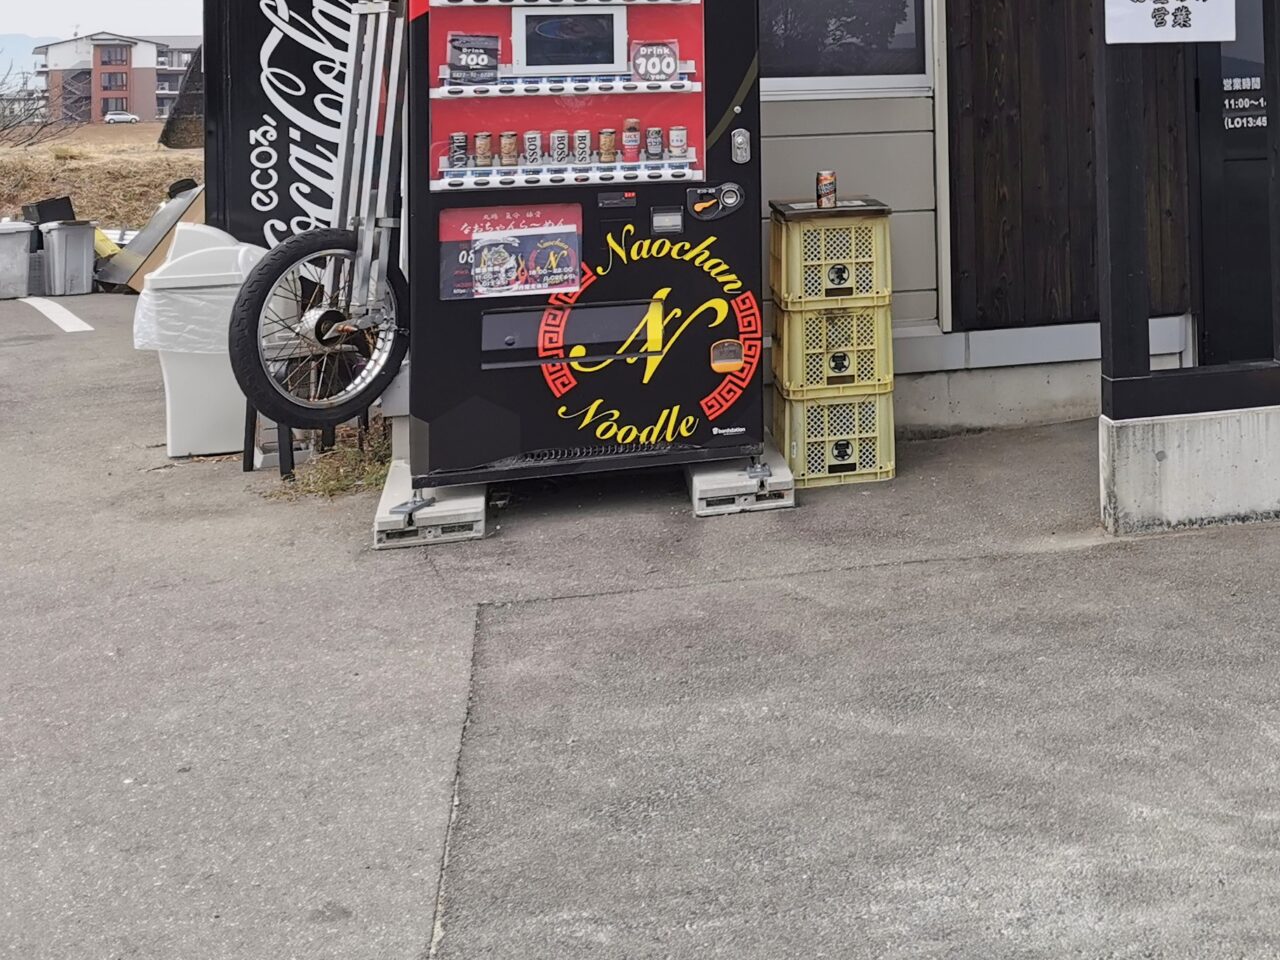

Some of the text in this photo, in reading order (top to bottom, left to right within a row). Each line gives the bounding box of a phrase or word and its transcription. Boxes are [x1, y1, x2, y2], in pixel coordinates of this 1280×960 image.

[1151, 5, 1192, 28] 営業
[458, 53, 489, 66] 100
[639, 46, 671, 55] Drink
[635, 56, 676, 75] 100
[1222, 76, 1261, 91] 営業時間
[453, 135, 466, 168] BLACK
[526, 136, 538, 164] BOSS
[556, 135, 566, 163] BOSS
[577, 135, 587, 163] BOSS
[596, 223, 744, 295] Naochan
[568, 287, 729, 384] N
[557, 398, 699, 445] Noodle
